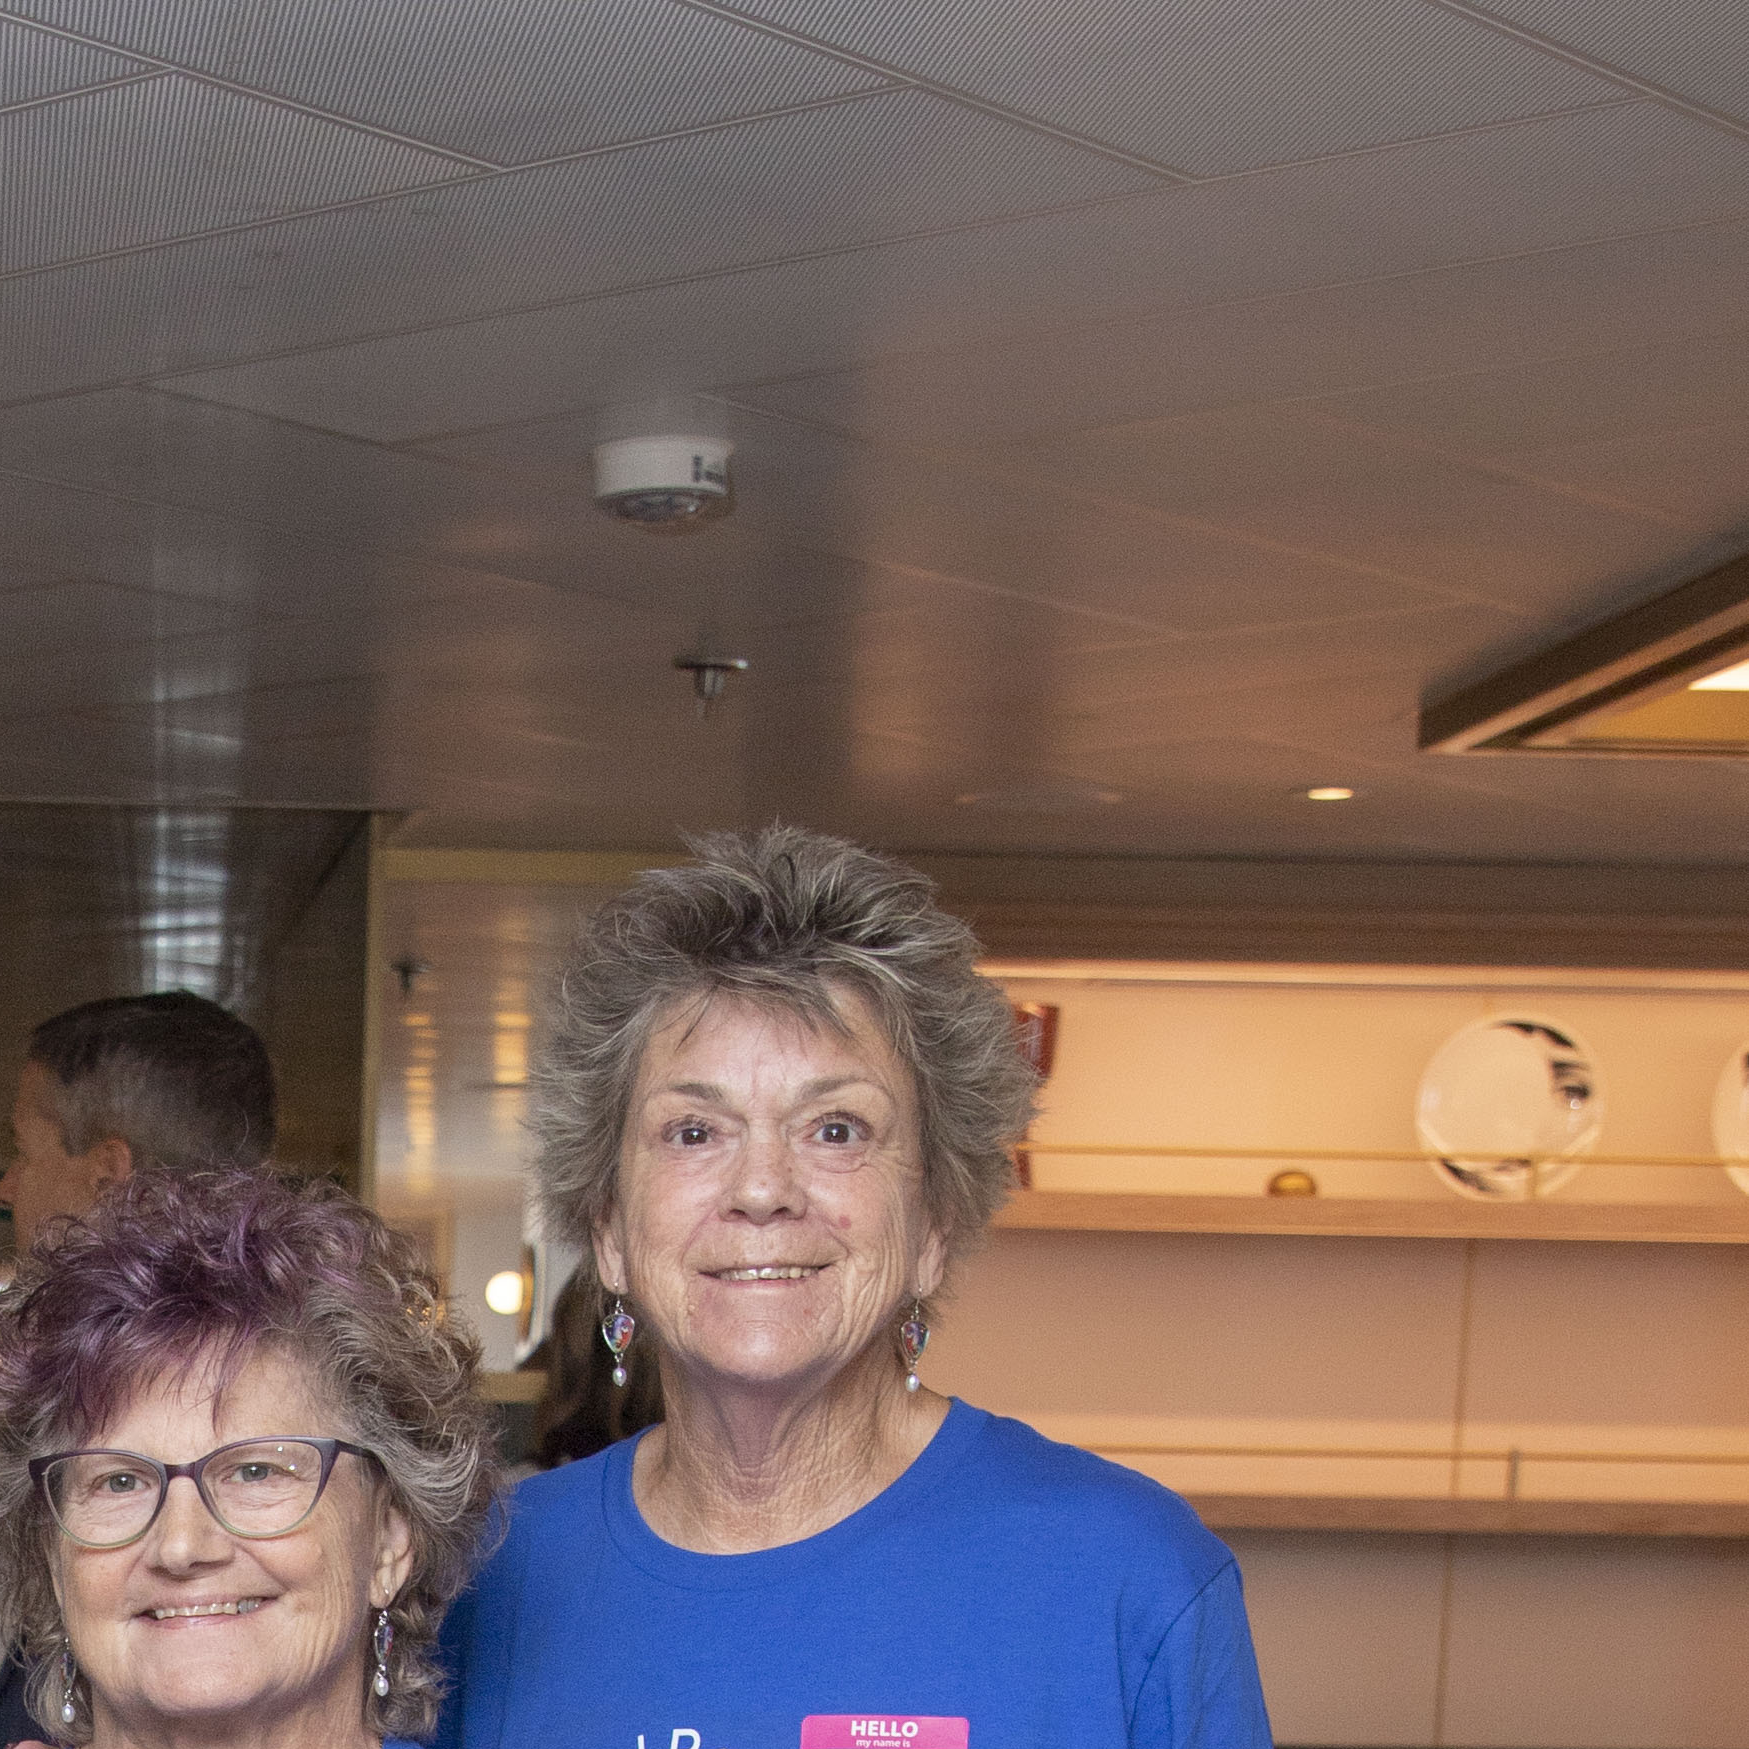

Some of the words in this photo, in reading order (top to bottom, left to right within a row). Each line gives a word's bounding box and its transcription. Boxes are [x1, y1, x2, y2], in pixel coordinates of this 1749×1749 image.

[851, 1720, 919, 1738] HELLO
[856, 1739, 871, 1748] my
[873, 1739, 900, 1748] name
[902, 1738, 911, 1748] is
